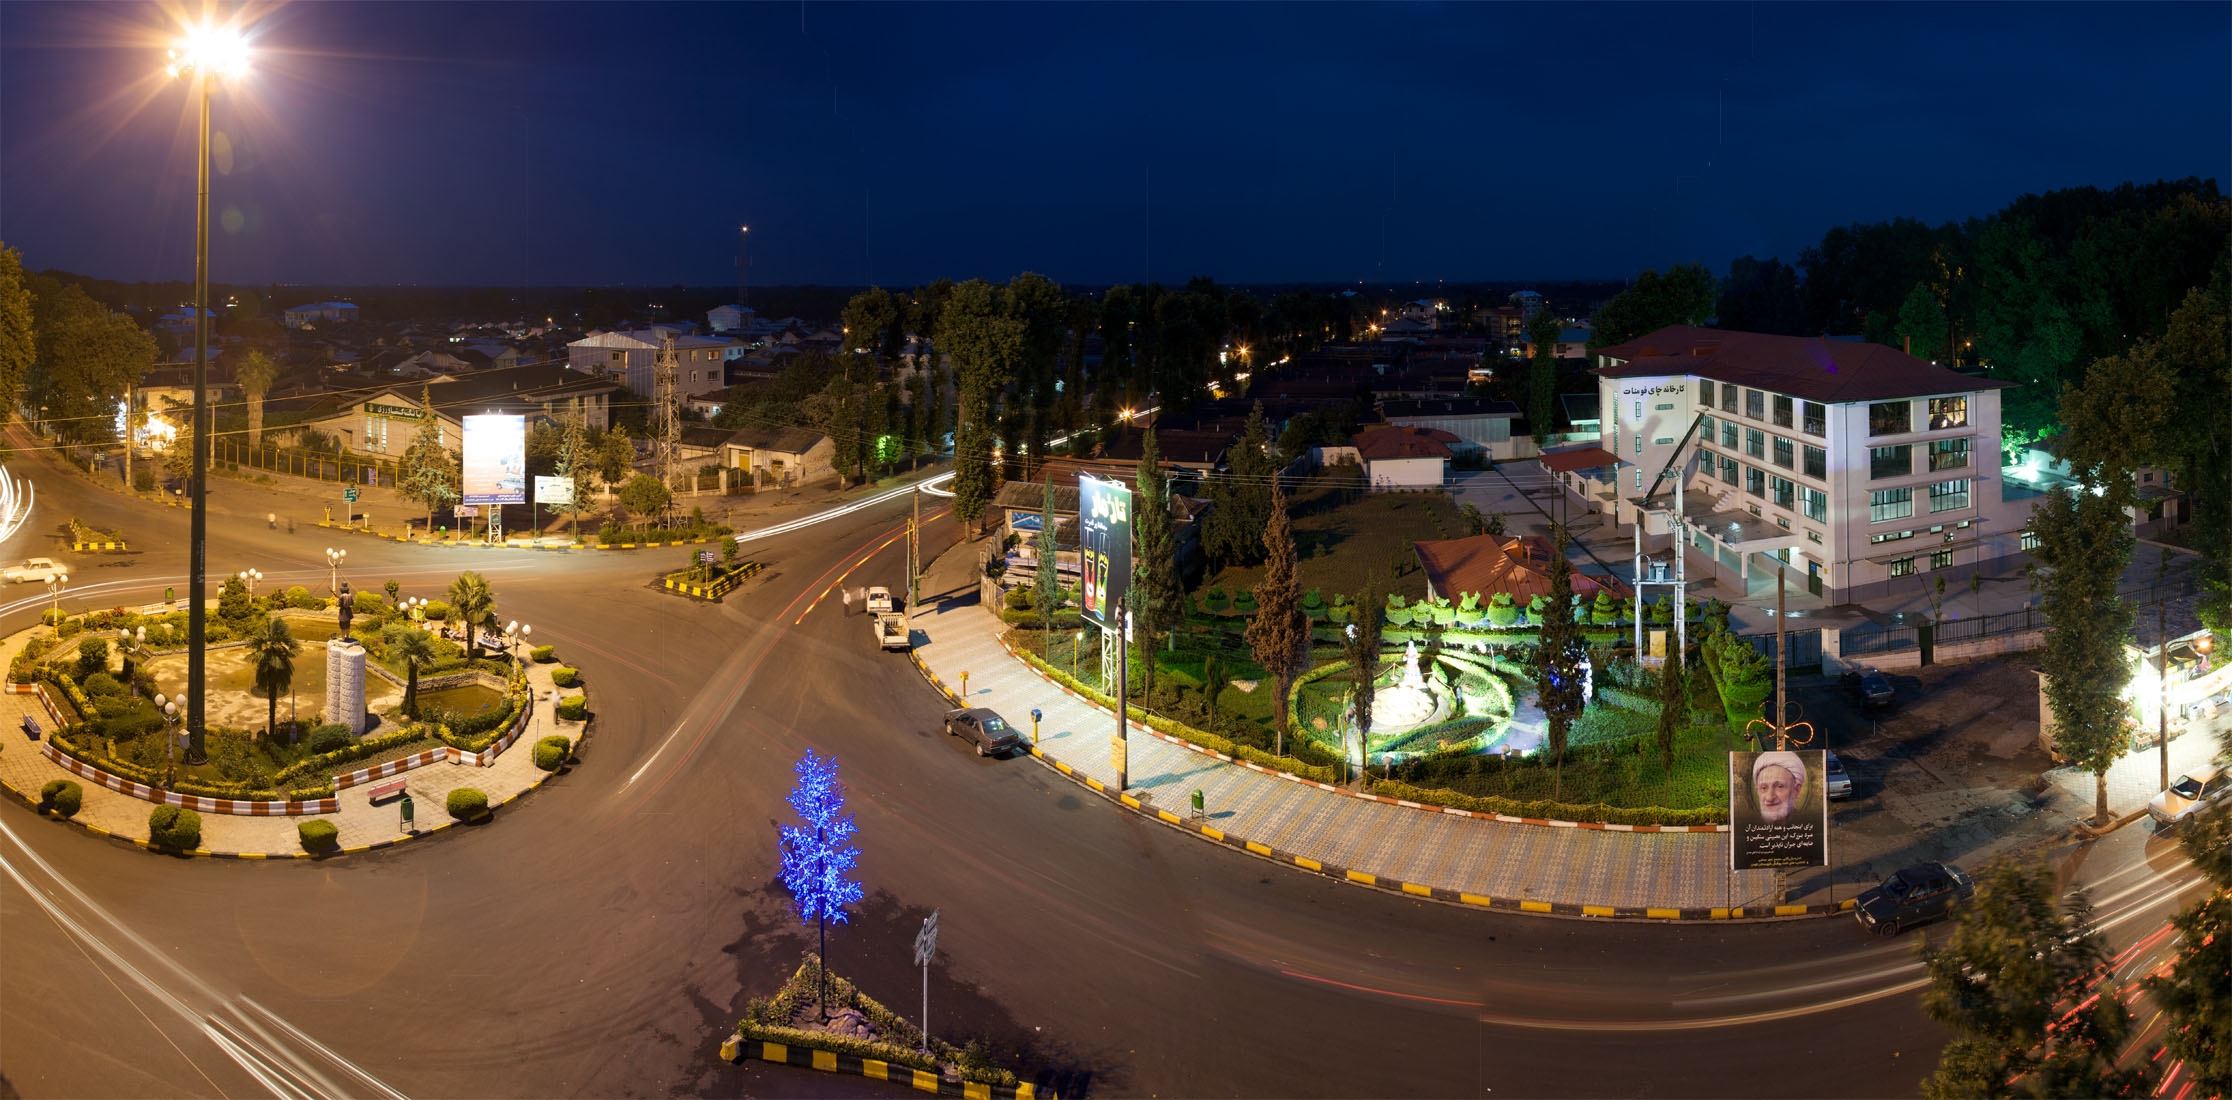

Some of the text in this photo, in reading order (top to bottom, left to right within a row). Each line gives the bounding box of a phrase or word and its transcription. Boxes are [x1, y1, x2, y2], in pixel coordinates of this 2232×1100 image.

[1623, 385, 1684, 396] کارخانه چای فومنات
[378, 405, 421, 417] بانک کشاورزی
